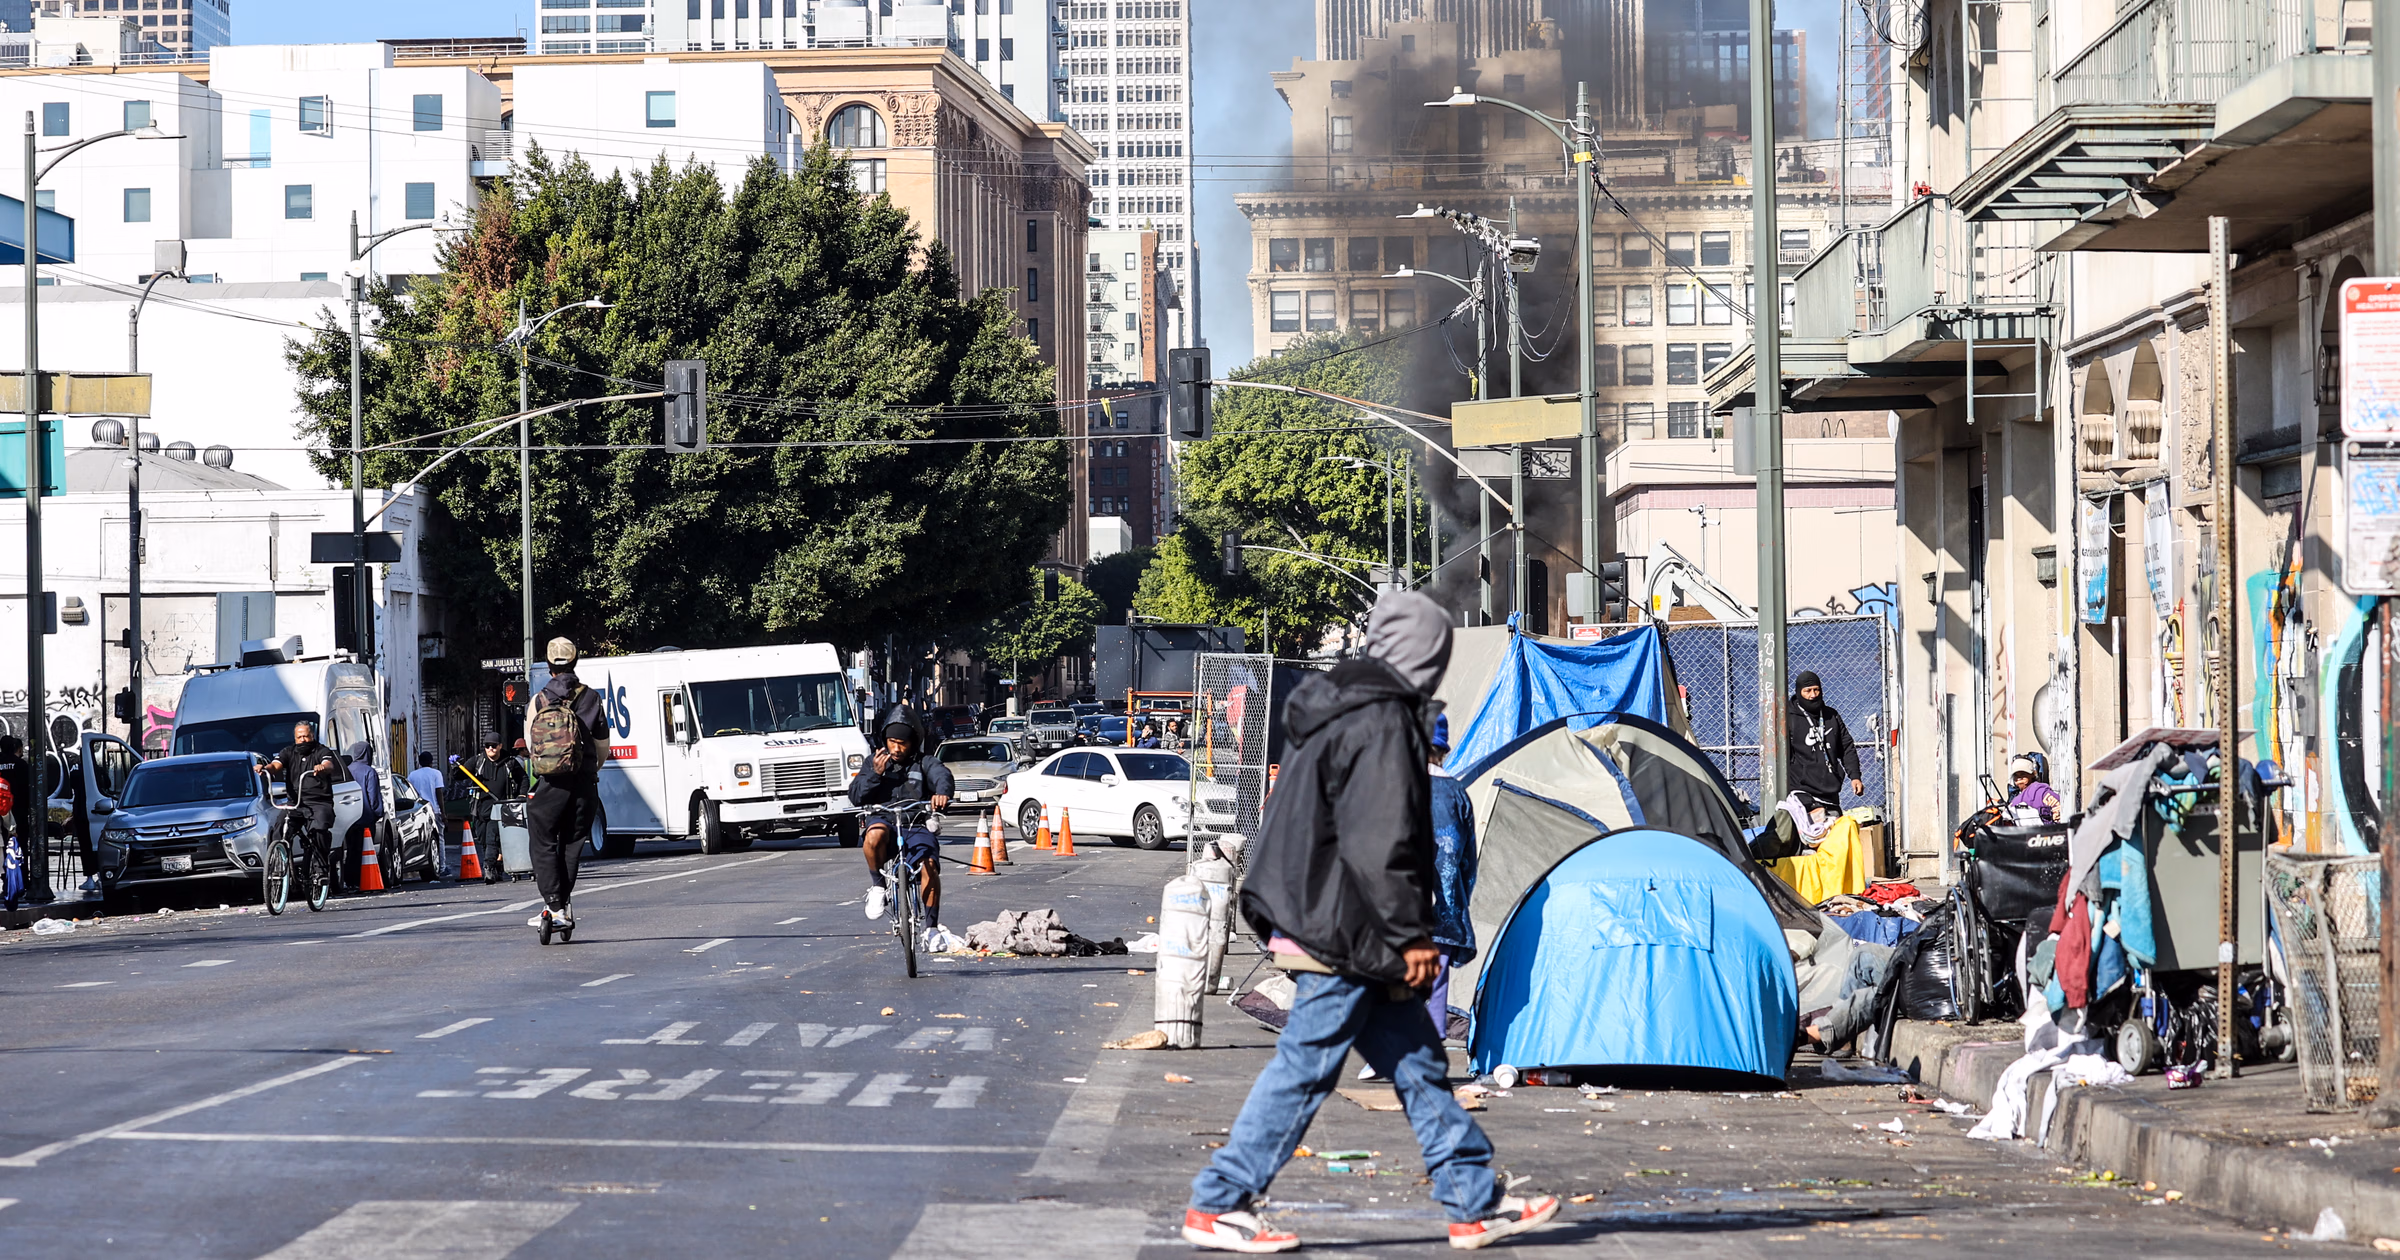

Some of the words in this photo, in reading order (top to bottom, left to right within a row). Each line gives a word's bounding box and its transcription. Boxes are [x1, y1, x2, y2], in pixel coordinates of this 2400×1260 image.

[1143, 255, 1152, 285] HOTEL
[1144, 293, 1152, 341] HAYWARD
[482, 660, 493, 668] SAN
[494, 659, 514, 667] JULIAN
[515, 658, 525, 666] ST.
[2027, 833, 2065, 848] drive
[601, 1021, 998, 1051] WAIT
[415, 1067, 994, 1109] HERE
